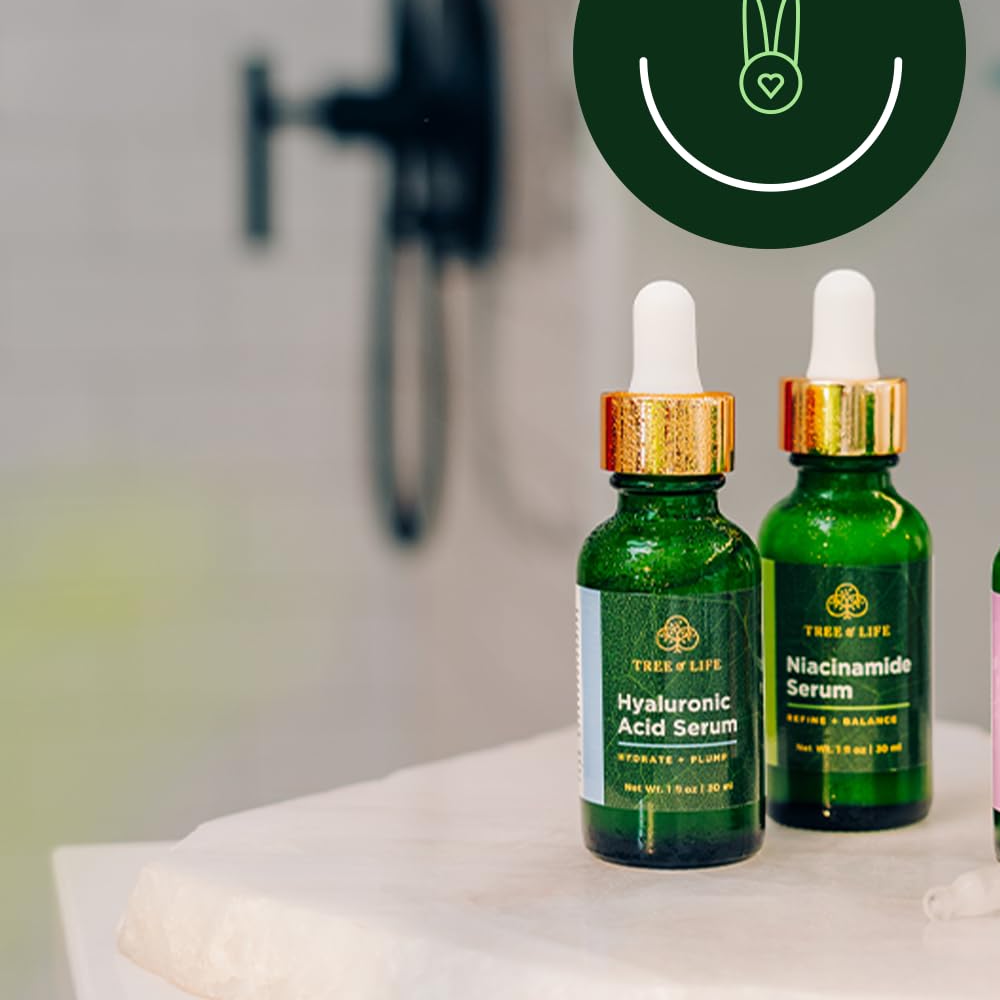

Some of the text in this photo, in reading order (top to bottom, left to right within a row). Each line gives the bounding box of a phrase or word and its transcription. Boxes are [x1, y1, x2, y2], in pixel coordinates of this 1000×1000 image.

[804, 625, 843, 638] TREE
[858, 625, 891, 638] LIFE
[632, 659, 672, 673] TREE
[689, 659, 722, 673] LIFE
[786, 655, 912, 677] Niacinamide
[786, 679, 853, 700] Serum
[617, 693, 731, 714] Hyaluronic
[617, 717, 738, 736] Acid Serum
[843, 714, 897, 726] BALANCE
[618, 753, 673, 764] HYDRATE
[690, 752, 727, 764] PLUMP
